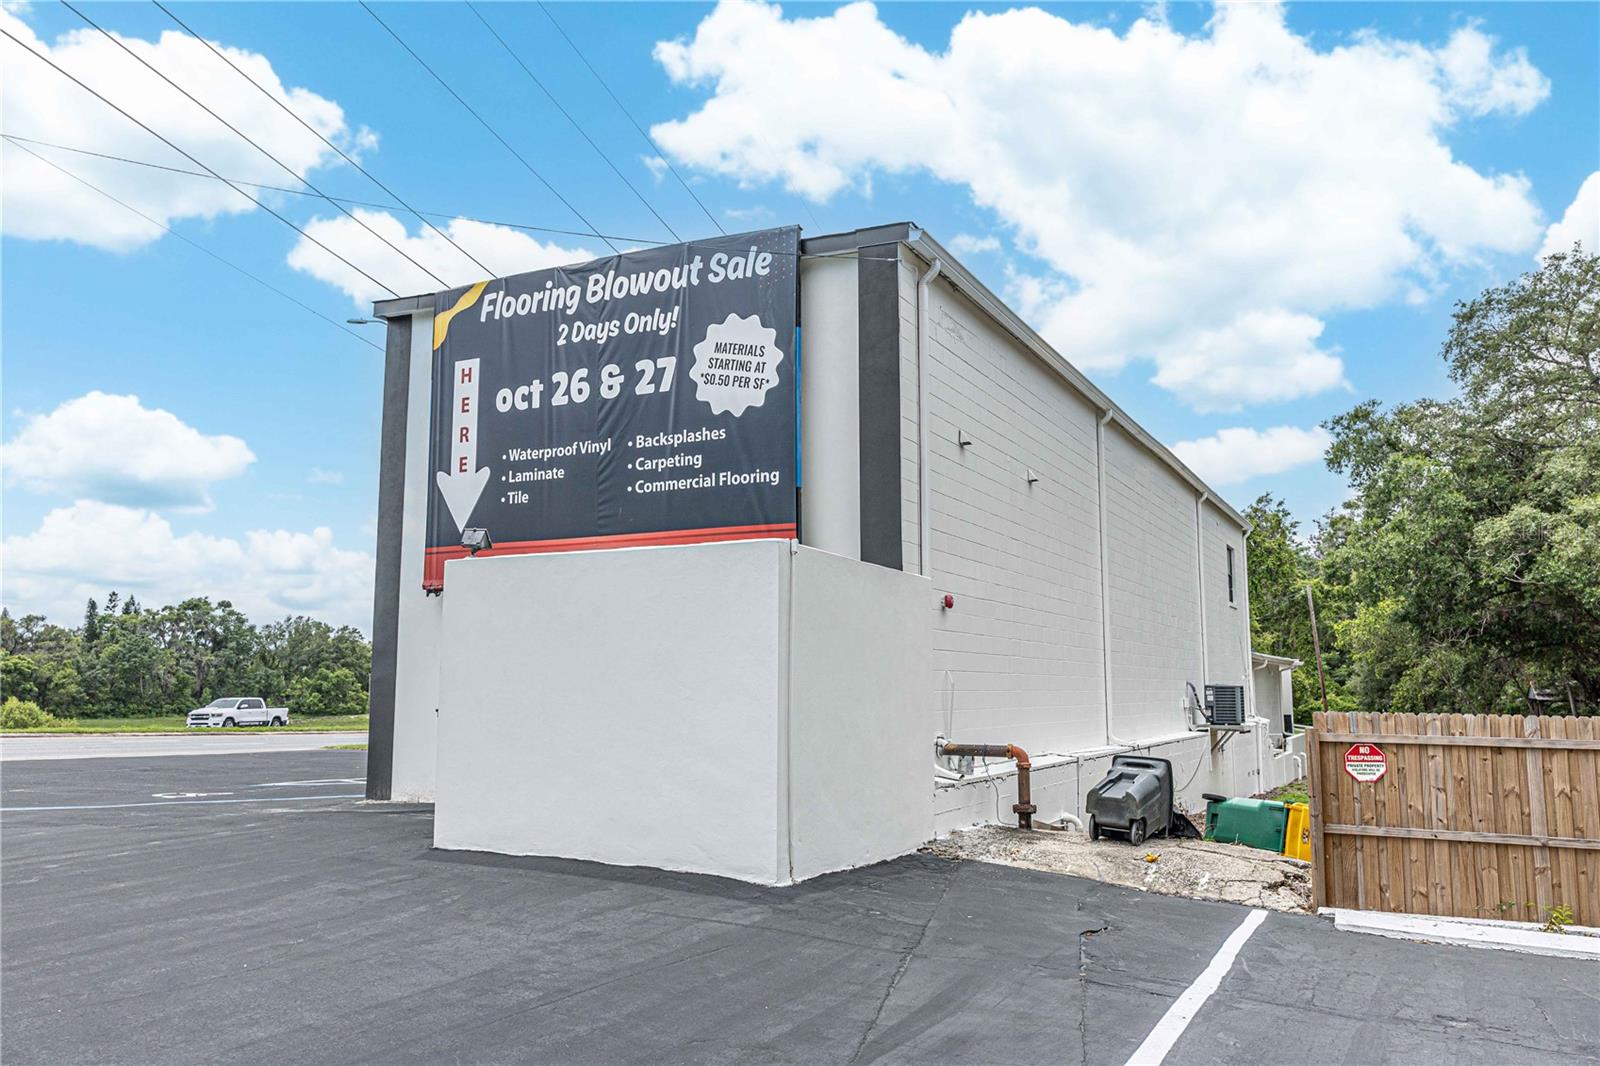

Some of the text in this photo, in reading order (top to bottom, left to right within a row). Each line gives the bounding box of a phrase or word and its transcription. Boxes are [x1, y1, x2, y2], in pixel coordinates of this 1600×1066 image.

[480, 245, 772, 322] Flooring Blowout Sale
[557, 305, 679, 346] 2 Days Only!
[714, 342, 765, 358] MATERIALS
[708, 357, 766, 374] STARTING AT
[496, 356, 677, 412] oct 26 & 27
[732, 375, 751, 389] PER
[636, 427, 726, 448] Backsplashes
[508, 437, 611, 461] Waterproof Vinyl
[635, 453, 702, 472] Carpeting
[508, 467, 565, 483] Laminate
[635, 469, 780, 493] Commercial Flooring
[507, 490, 529, 504] Tile
[1359, 746, 1370, 754] NO
